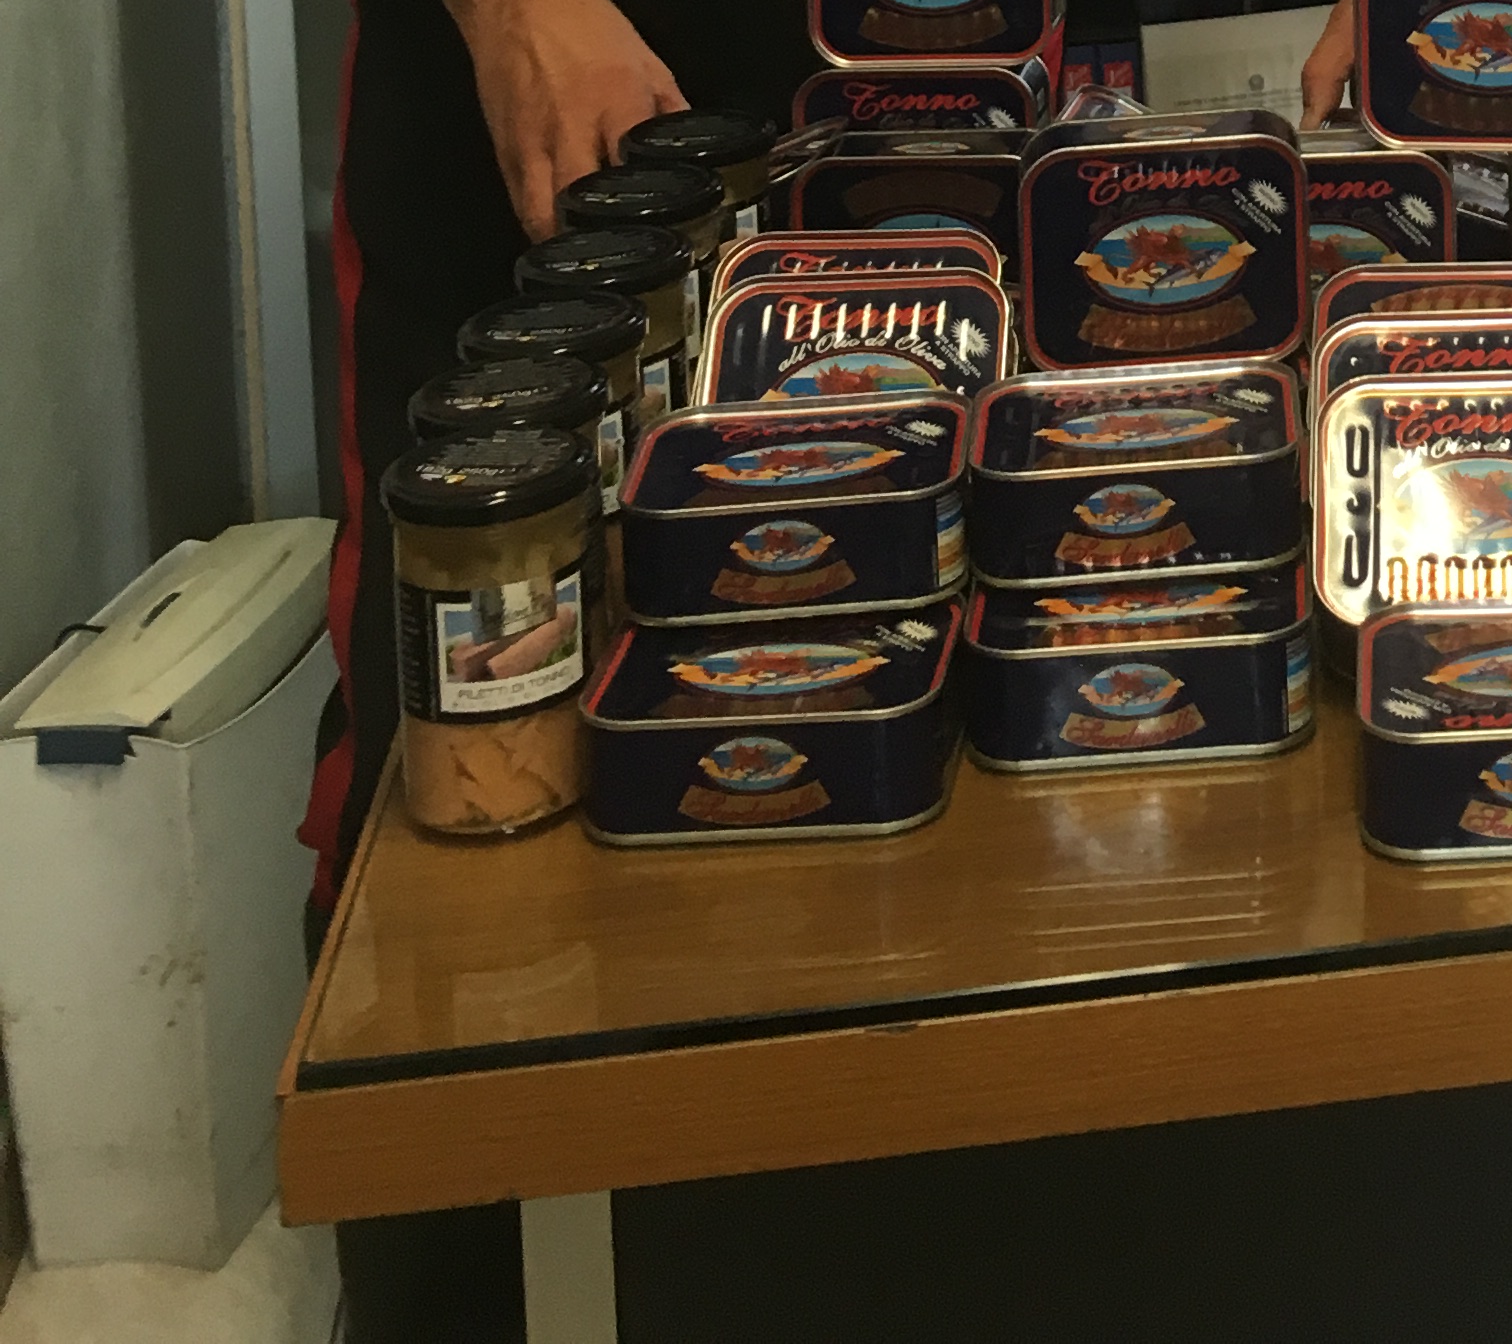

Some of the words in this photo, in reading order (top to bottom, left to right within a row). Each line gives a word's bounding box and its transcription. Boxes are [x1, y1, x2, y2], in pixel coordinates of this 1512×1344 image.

[844, 81, 981, 121] Tonno
[1076, 159, 1241, 206] Tonno
[1308, 180, 1394, 200] nno
[776, 294, 946, 343] Tonno
[778, 340, 812, 373] all'
[815, 331, 860, 355] Olio
[864, 330, 886, 347] di
[894, 334, 946, 371] Oliva
[1430, 435, 1481, 460] Olio
[1484, 435, 1511, 452] di
[511, 682, 525, 694] DI
